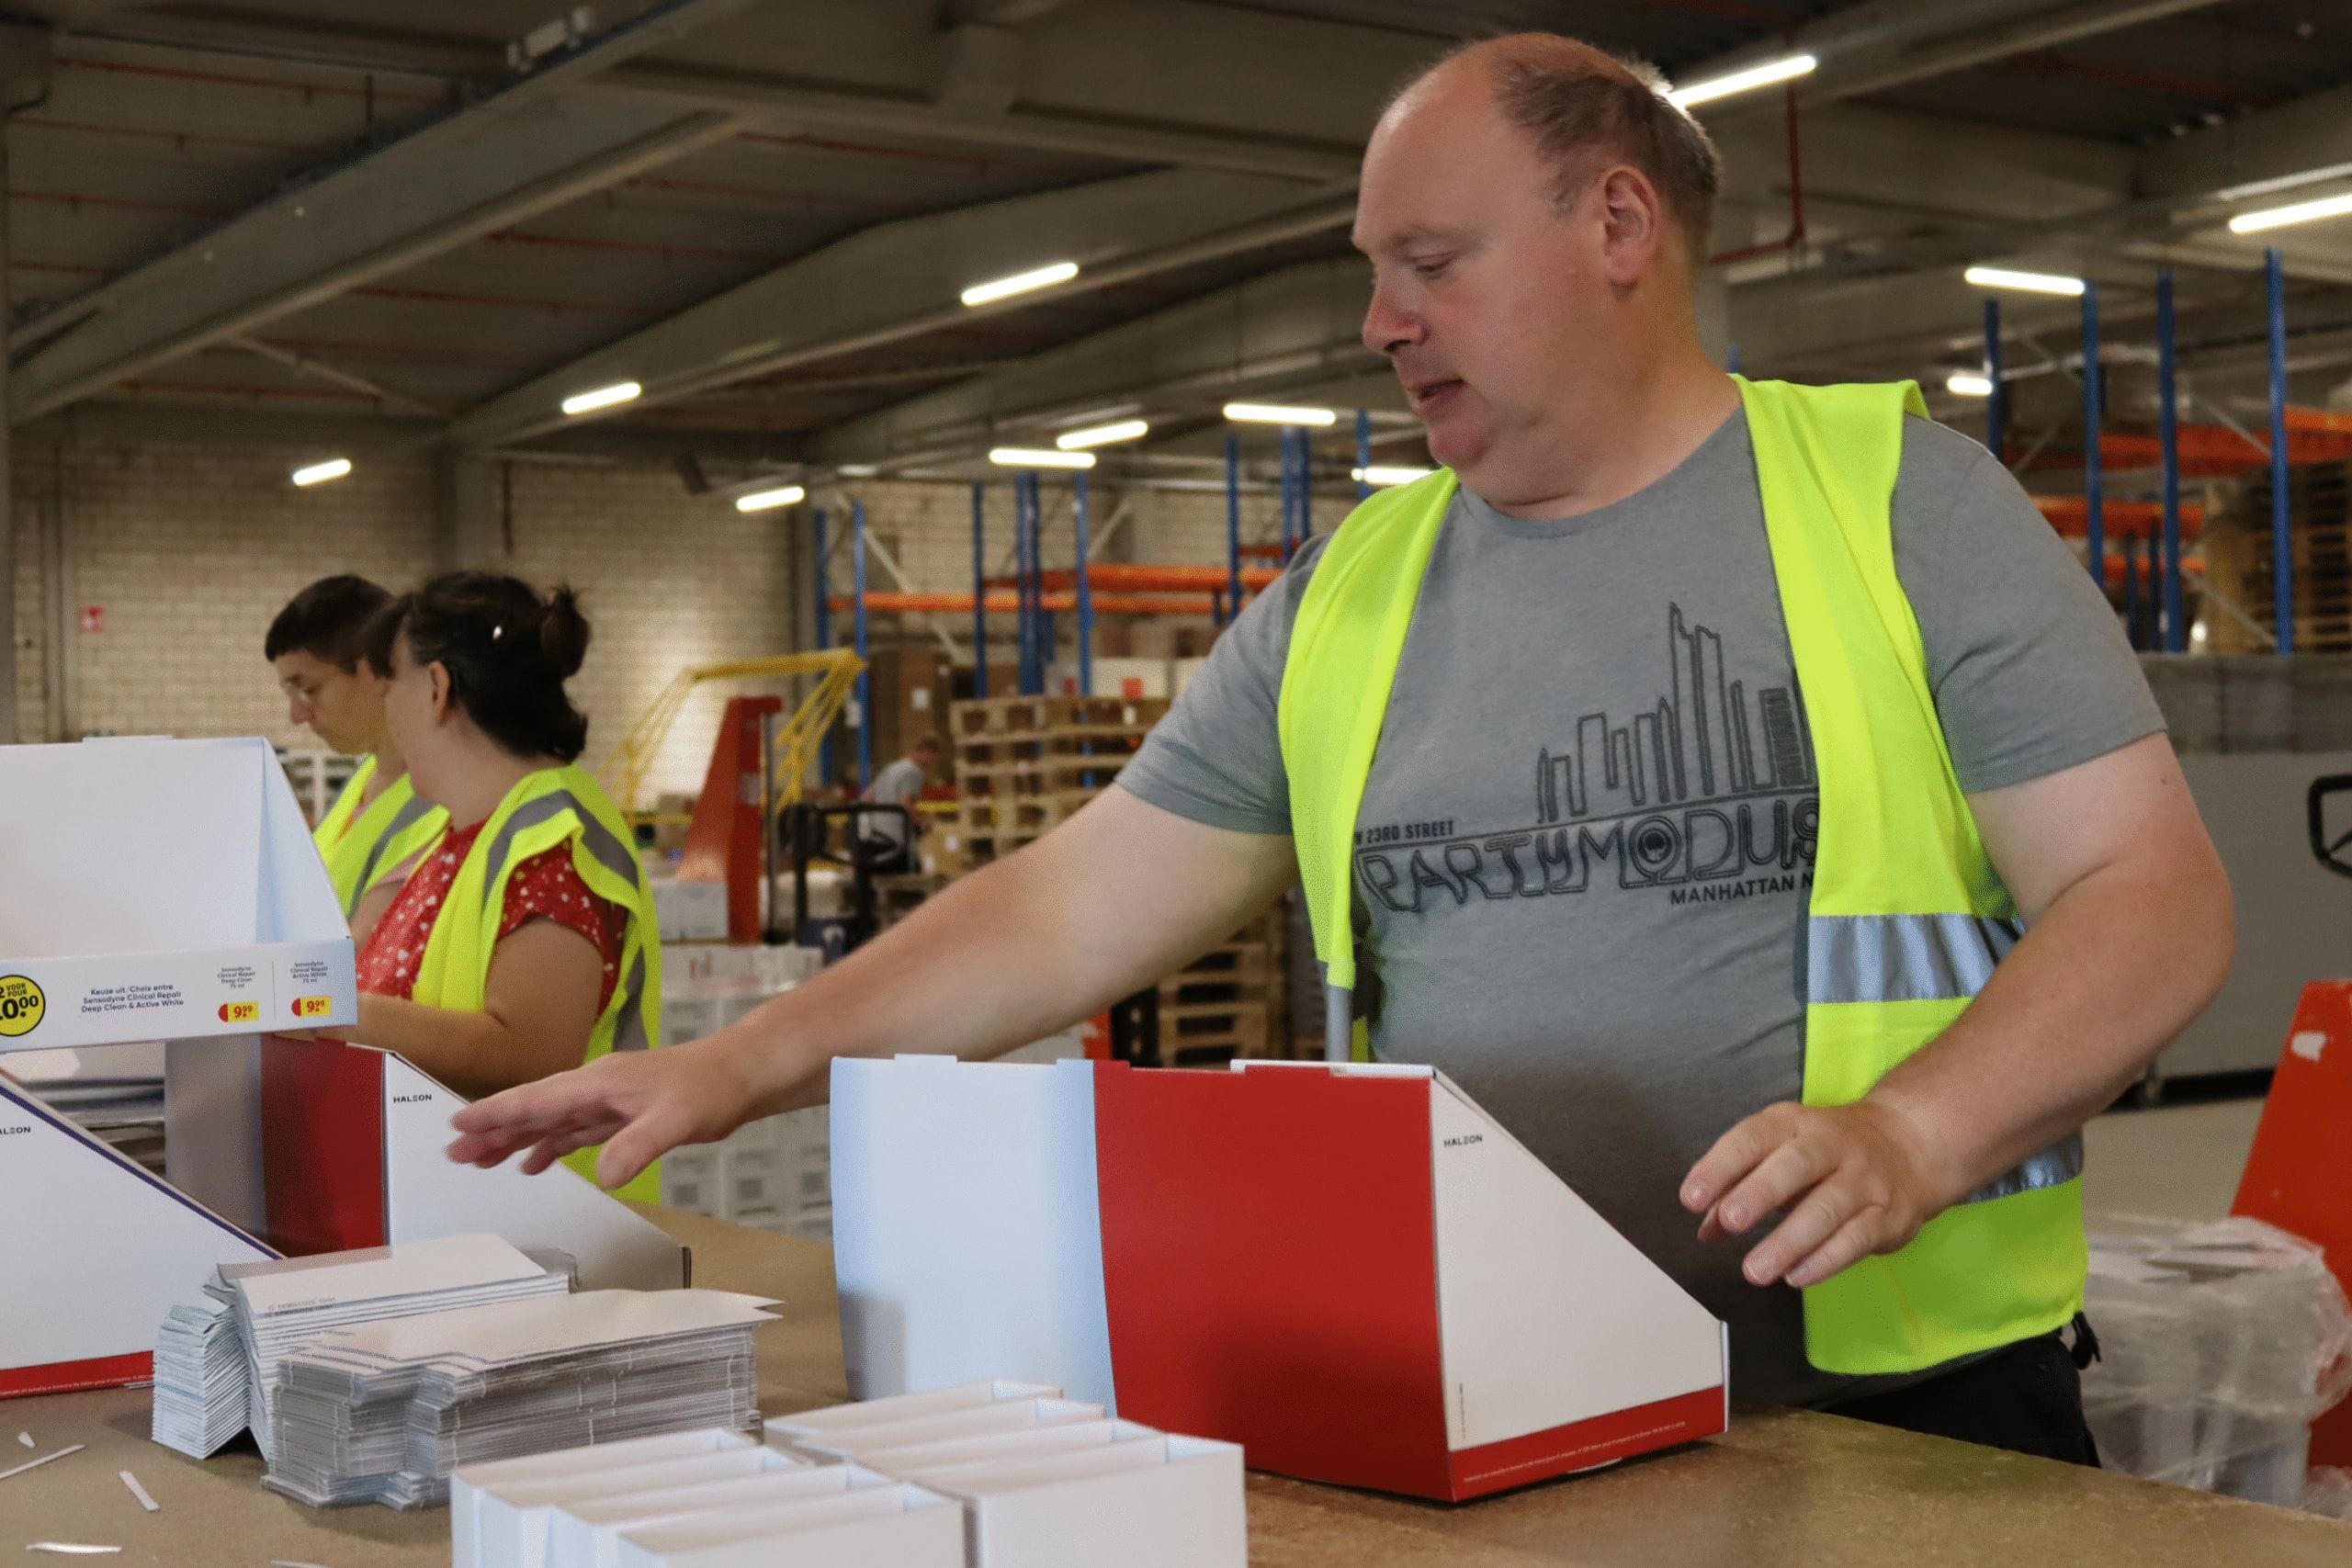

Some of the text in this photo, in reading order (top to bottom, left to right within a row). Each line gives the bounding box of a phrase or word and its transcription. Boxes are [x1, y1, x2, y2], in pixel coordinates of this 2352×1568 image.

[1366, 826, 1400, 843] 23RD
[1405, 820, 1454, 839] STREET
[1670, 874, 1795, 905] MANHATTAN
[6, 982, 26, 990] VOOR
[130, 985, 152, 993] Choix
[7, 988, 28, 998] POUR
[83, 991, 182, 1004] Sensodyne Clinical Repair
[81, 1005, 102, 1013] Deep
[136, 1000, 160, 1009] Active
[162, 998, 184, 1007] White
[393, 1094, 432, 1103] HALEON
[0, 1126, 30, 1135] LEON
[1443, 1134, 1483, 1146] HALEON
